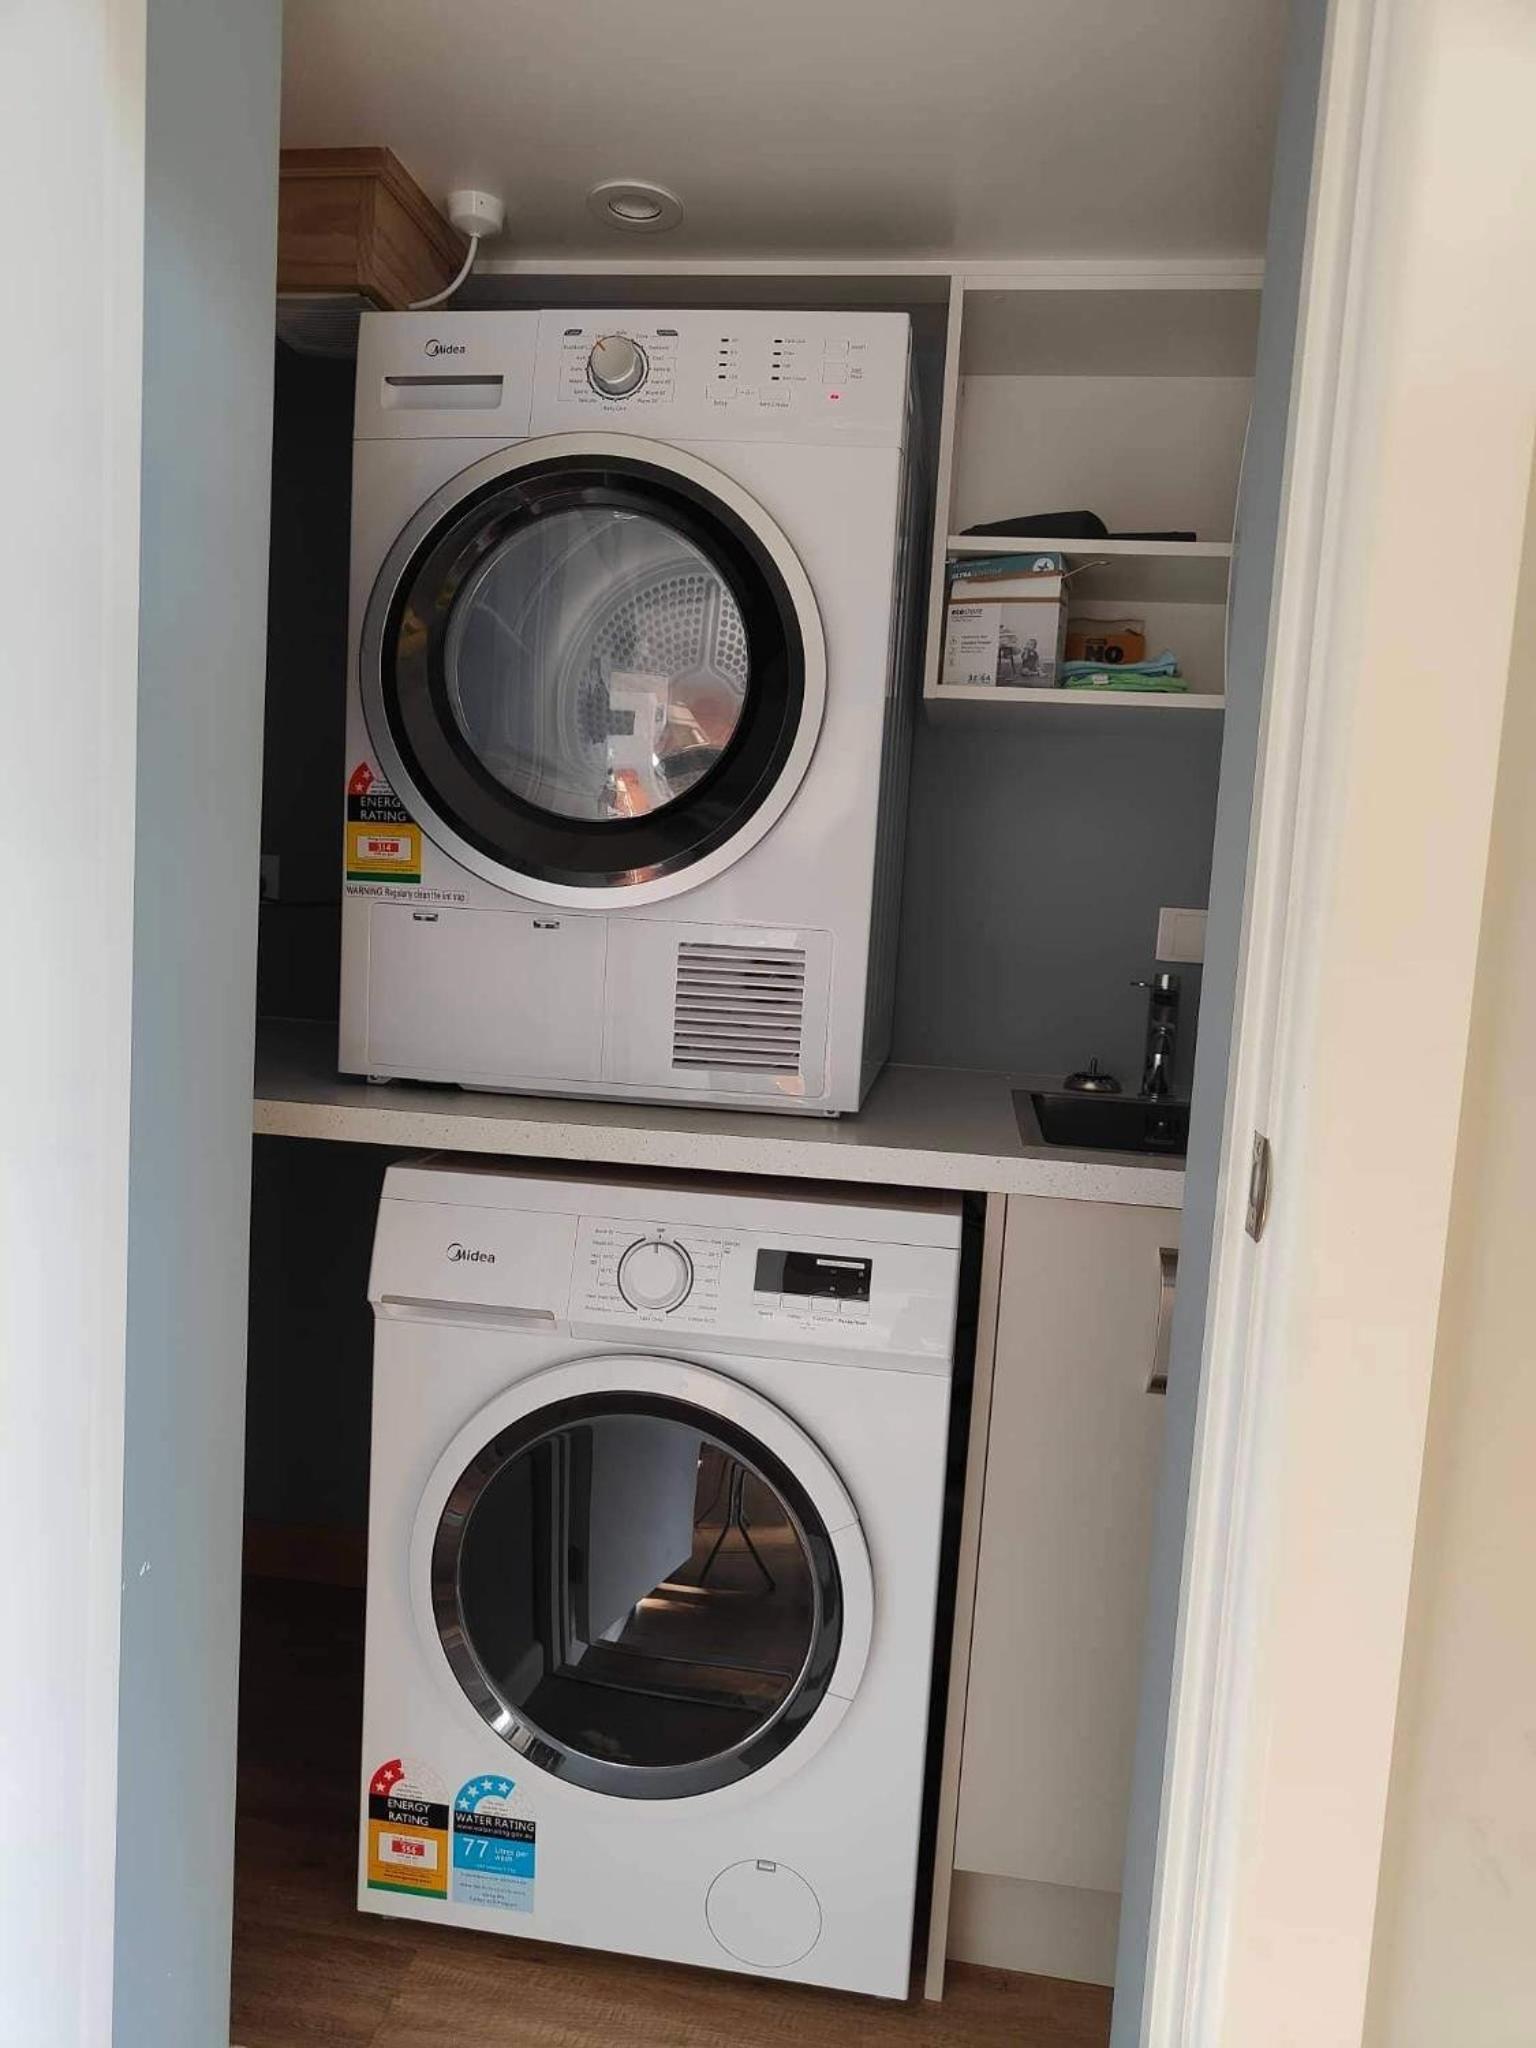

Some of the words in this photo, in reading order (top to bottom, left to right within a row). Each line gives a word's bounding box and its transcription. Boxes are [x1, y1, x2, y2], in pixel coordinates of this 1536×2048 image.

[425, 339, 465, 357] Midea
[360, 795, 402, 808] ENERG
[360, 810, 407, 821] RATING
[346, 885, 383, 896] WARNING
[447, 1242, 496, 1264] Midea
[387, 1798, 432, 1814] ENERGY
[388, 1811, 430, 1826] RATING
[455, 1812, 493, 1827] WATER
[494, 1818, 535, 1832] RATING
[462, 1837, 489, 1858] 77
